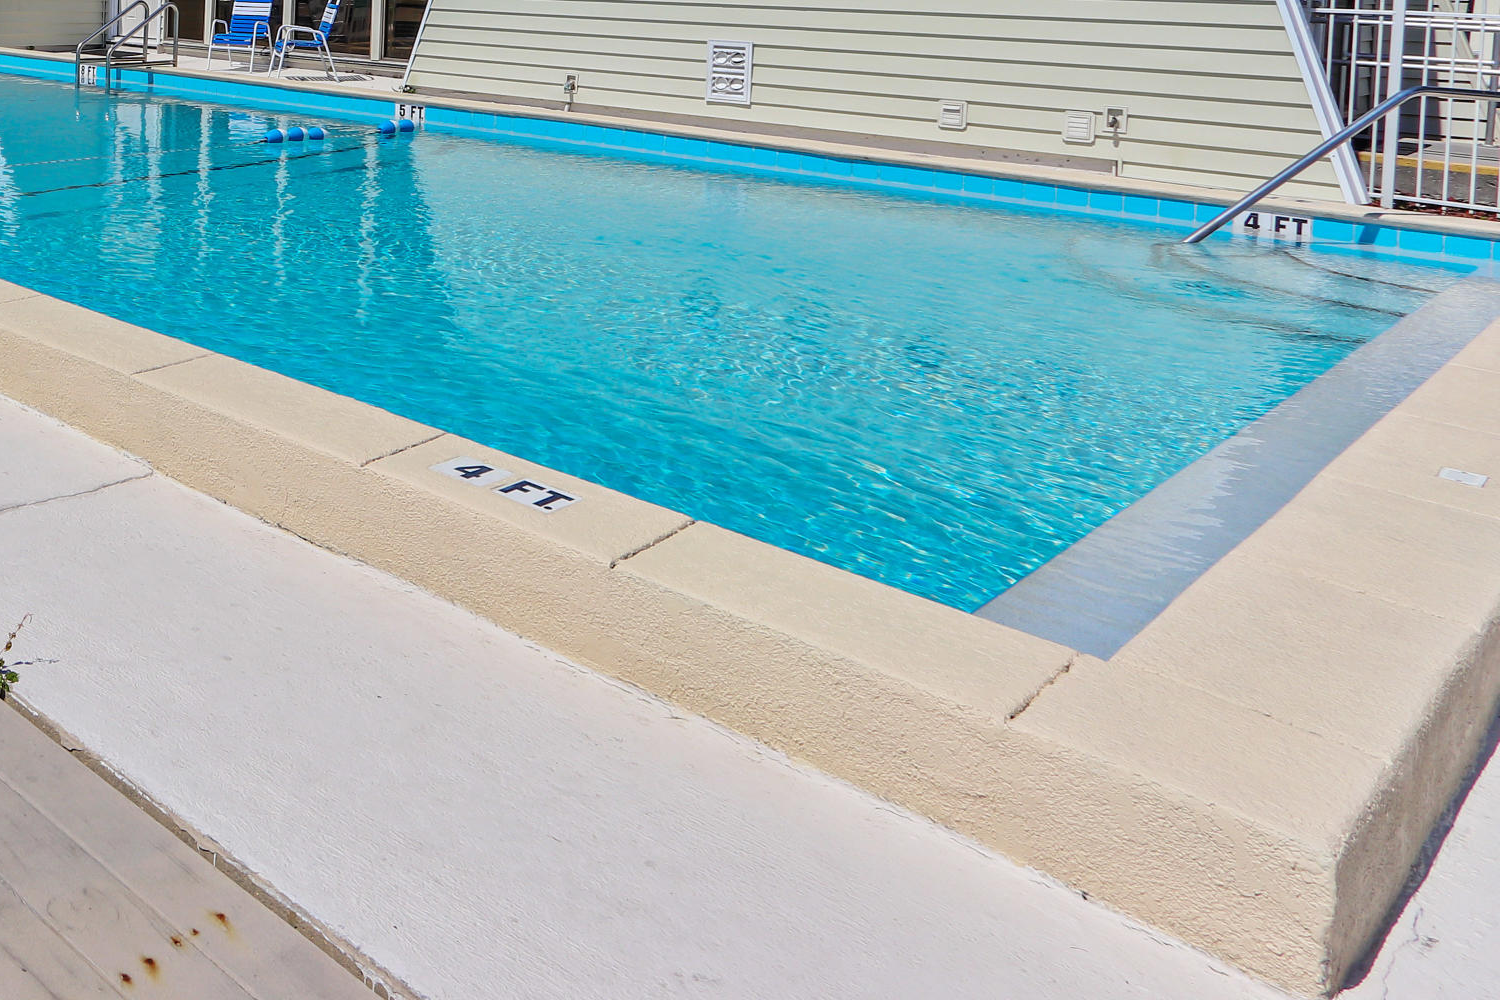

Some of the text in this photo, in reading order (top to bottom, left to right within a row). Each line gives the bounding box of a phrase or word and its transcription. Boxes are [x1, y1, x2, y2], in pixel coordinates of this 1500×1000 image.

[399, 104, 406, 117] 5
[1243, 212, 1308, 236] 4 FT
[454, 465, 495, 480] 4
